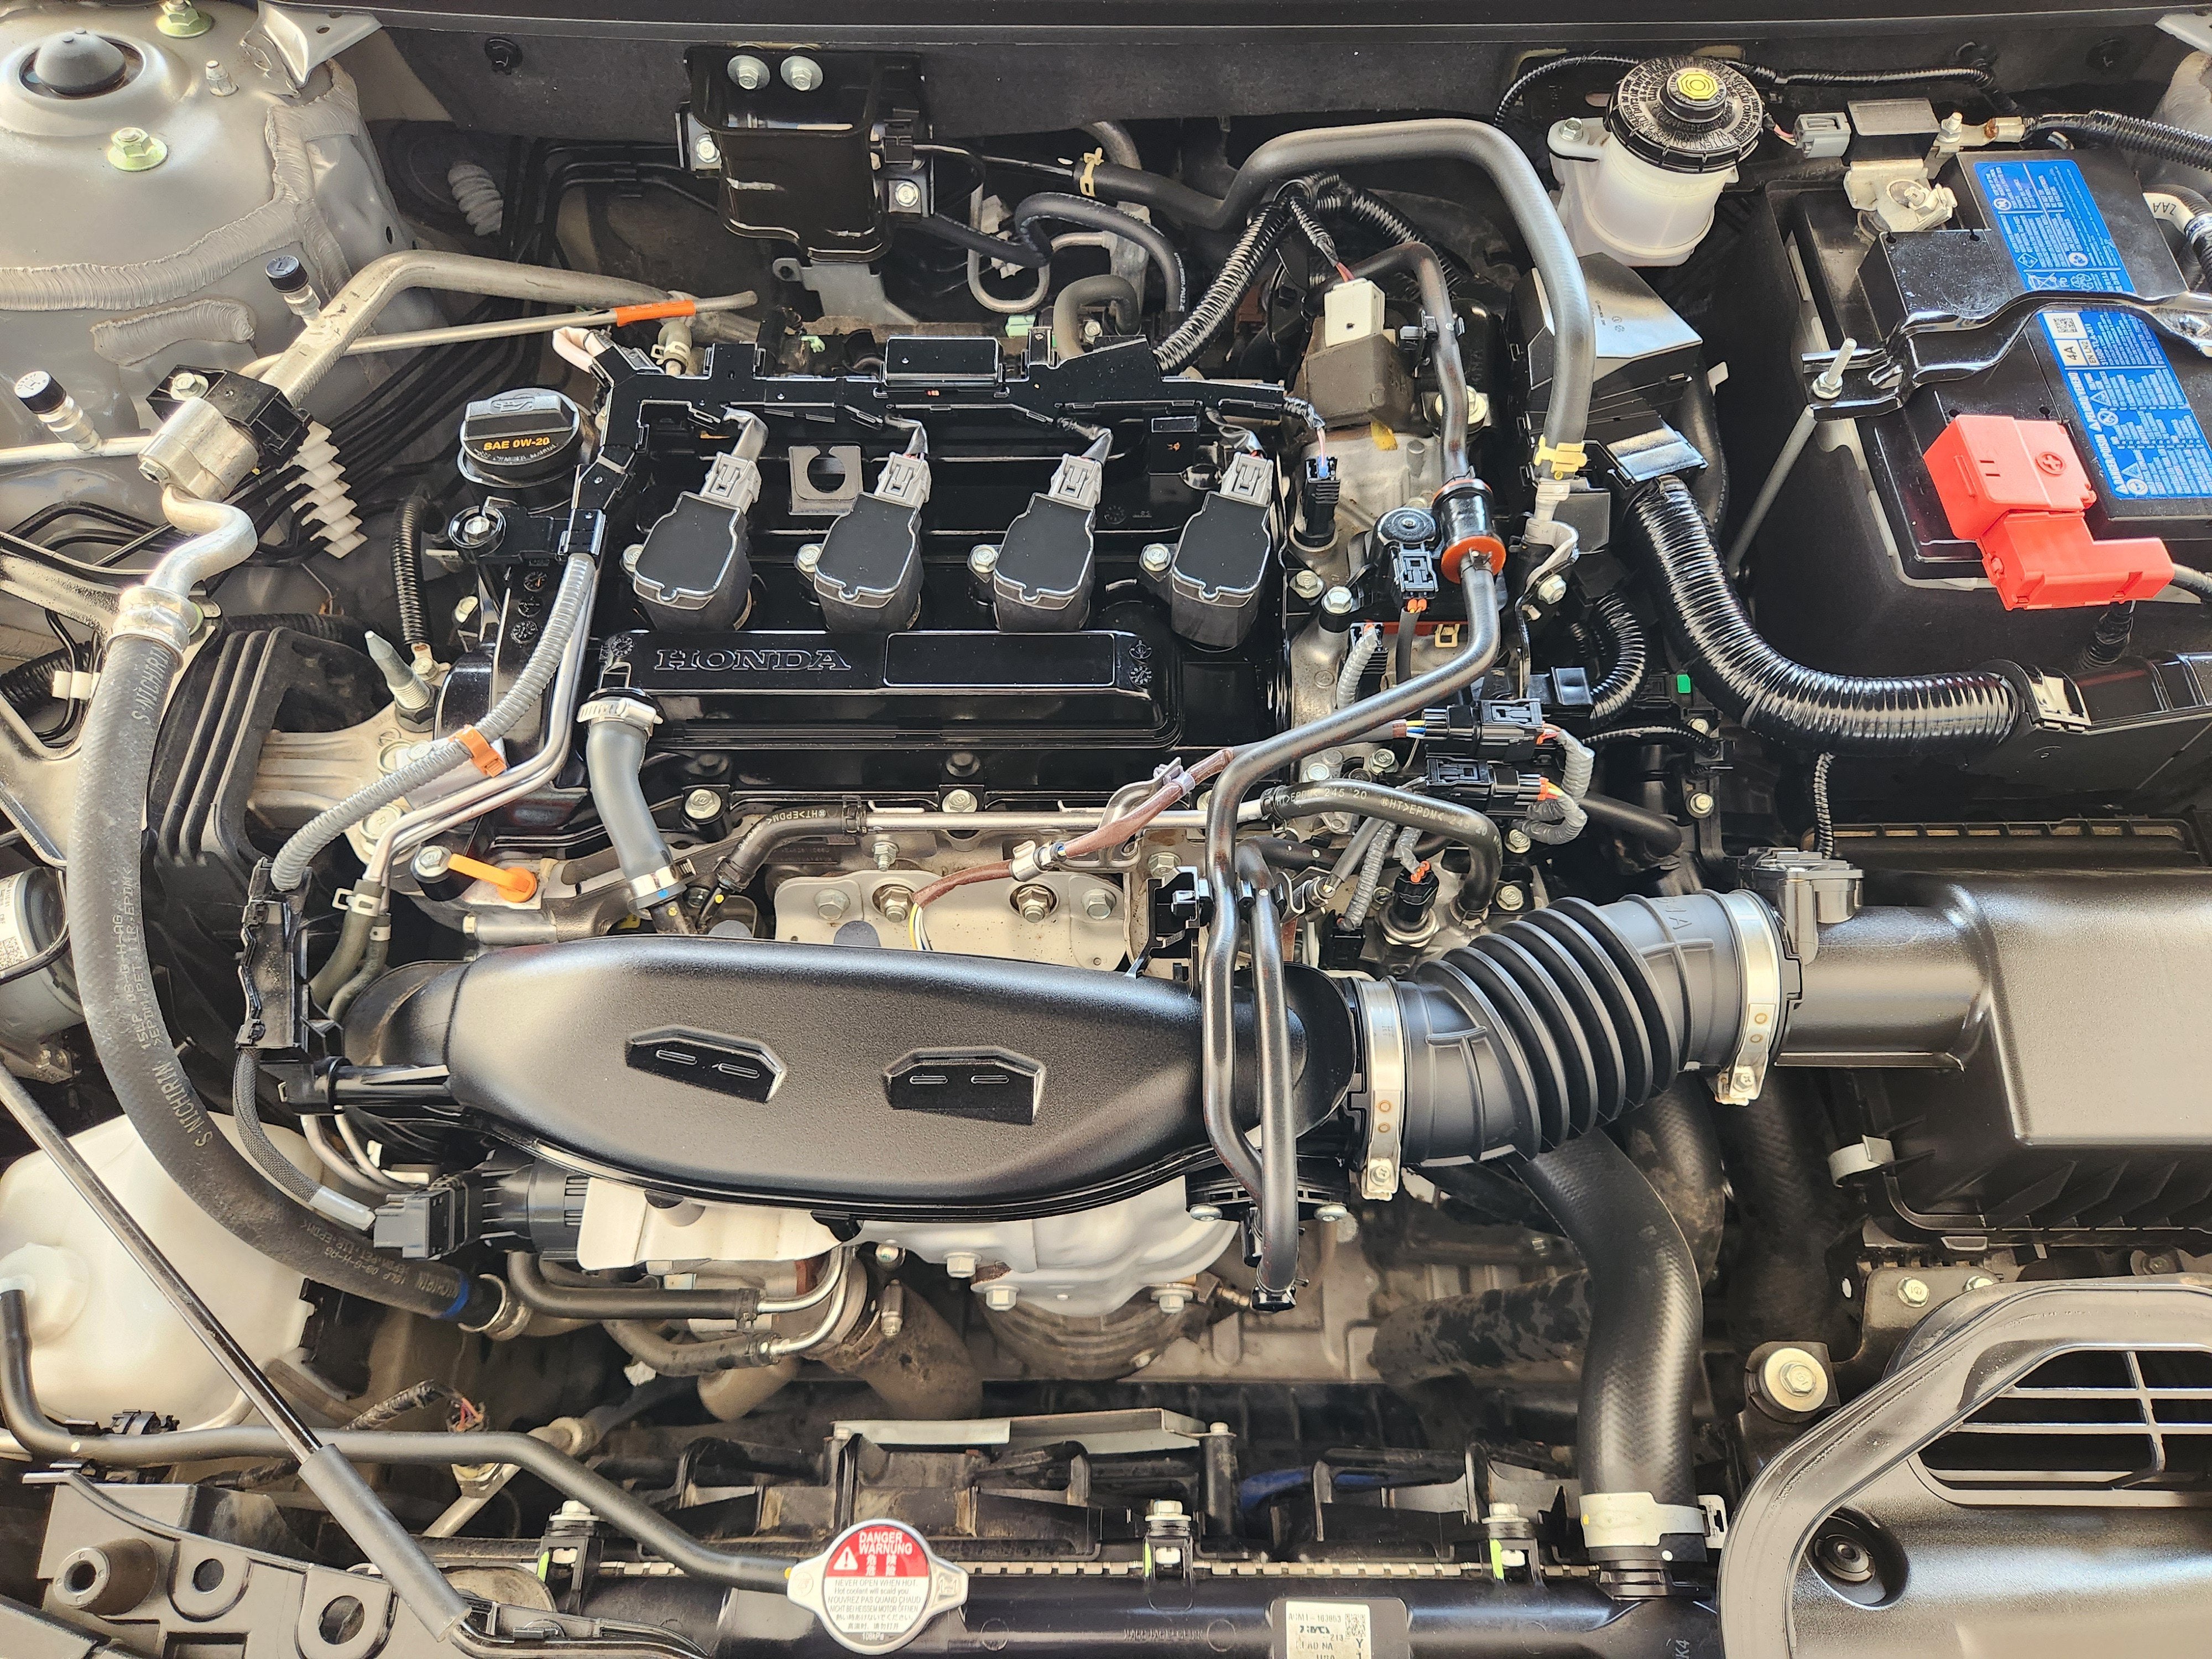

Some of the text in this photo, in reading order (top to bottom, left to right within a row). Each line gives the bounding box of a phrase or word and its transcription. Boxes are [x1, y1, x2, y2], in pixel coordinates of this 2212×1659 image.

[1673, 135, 1732, 150] ATTENTION
[2060, 345, 2080, 361] 4A
[2080, 340, 2093, 353] LN2
[2085, 354, 2097, 363] EN
[483, 436, 550, 451] SAE 0W-20
[654, 649, 852, 671] HONDA
[1324, 788, 1345, 798] 245
[1353, 789, 1368, 800] 20
[859, 1531, 904, 1543] DANGER
[859, 1542, 913, 1555] WARNUNG
[835, 1579, 859, 1587] NEVER
[859, 1579, 878, 1587] OPEN
[880, 1579, 901, 1587] WHEN
